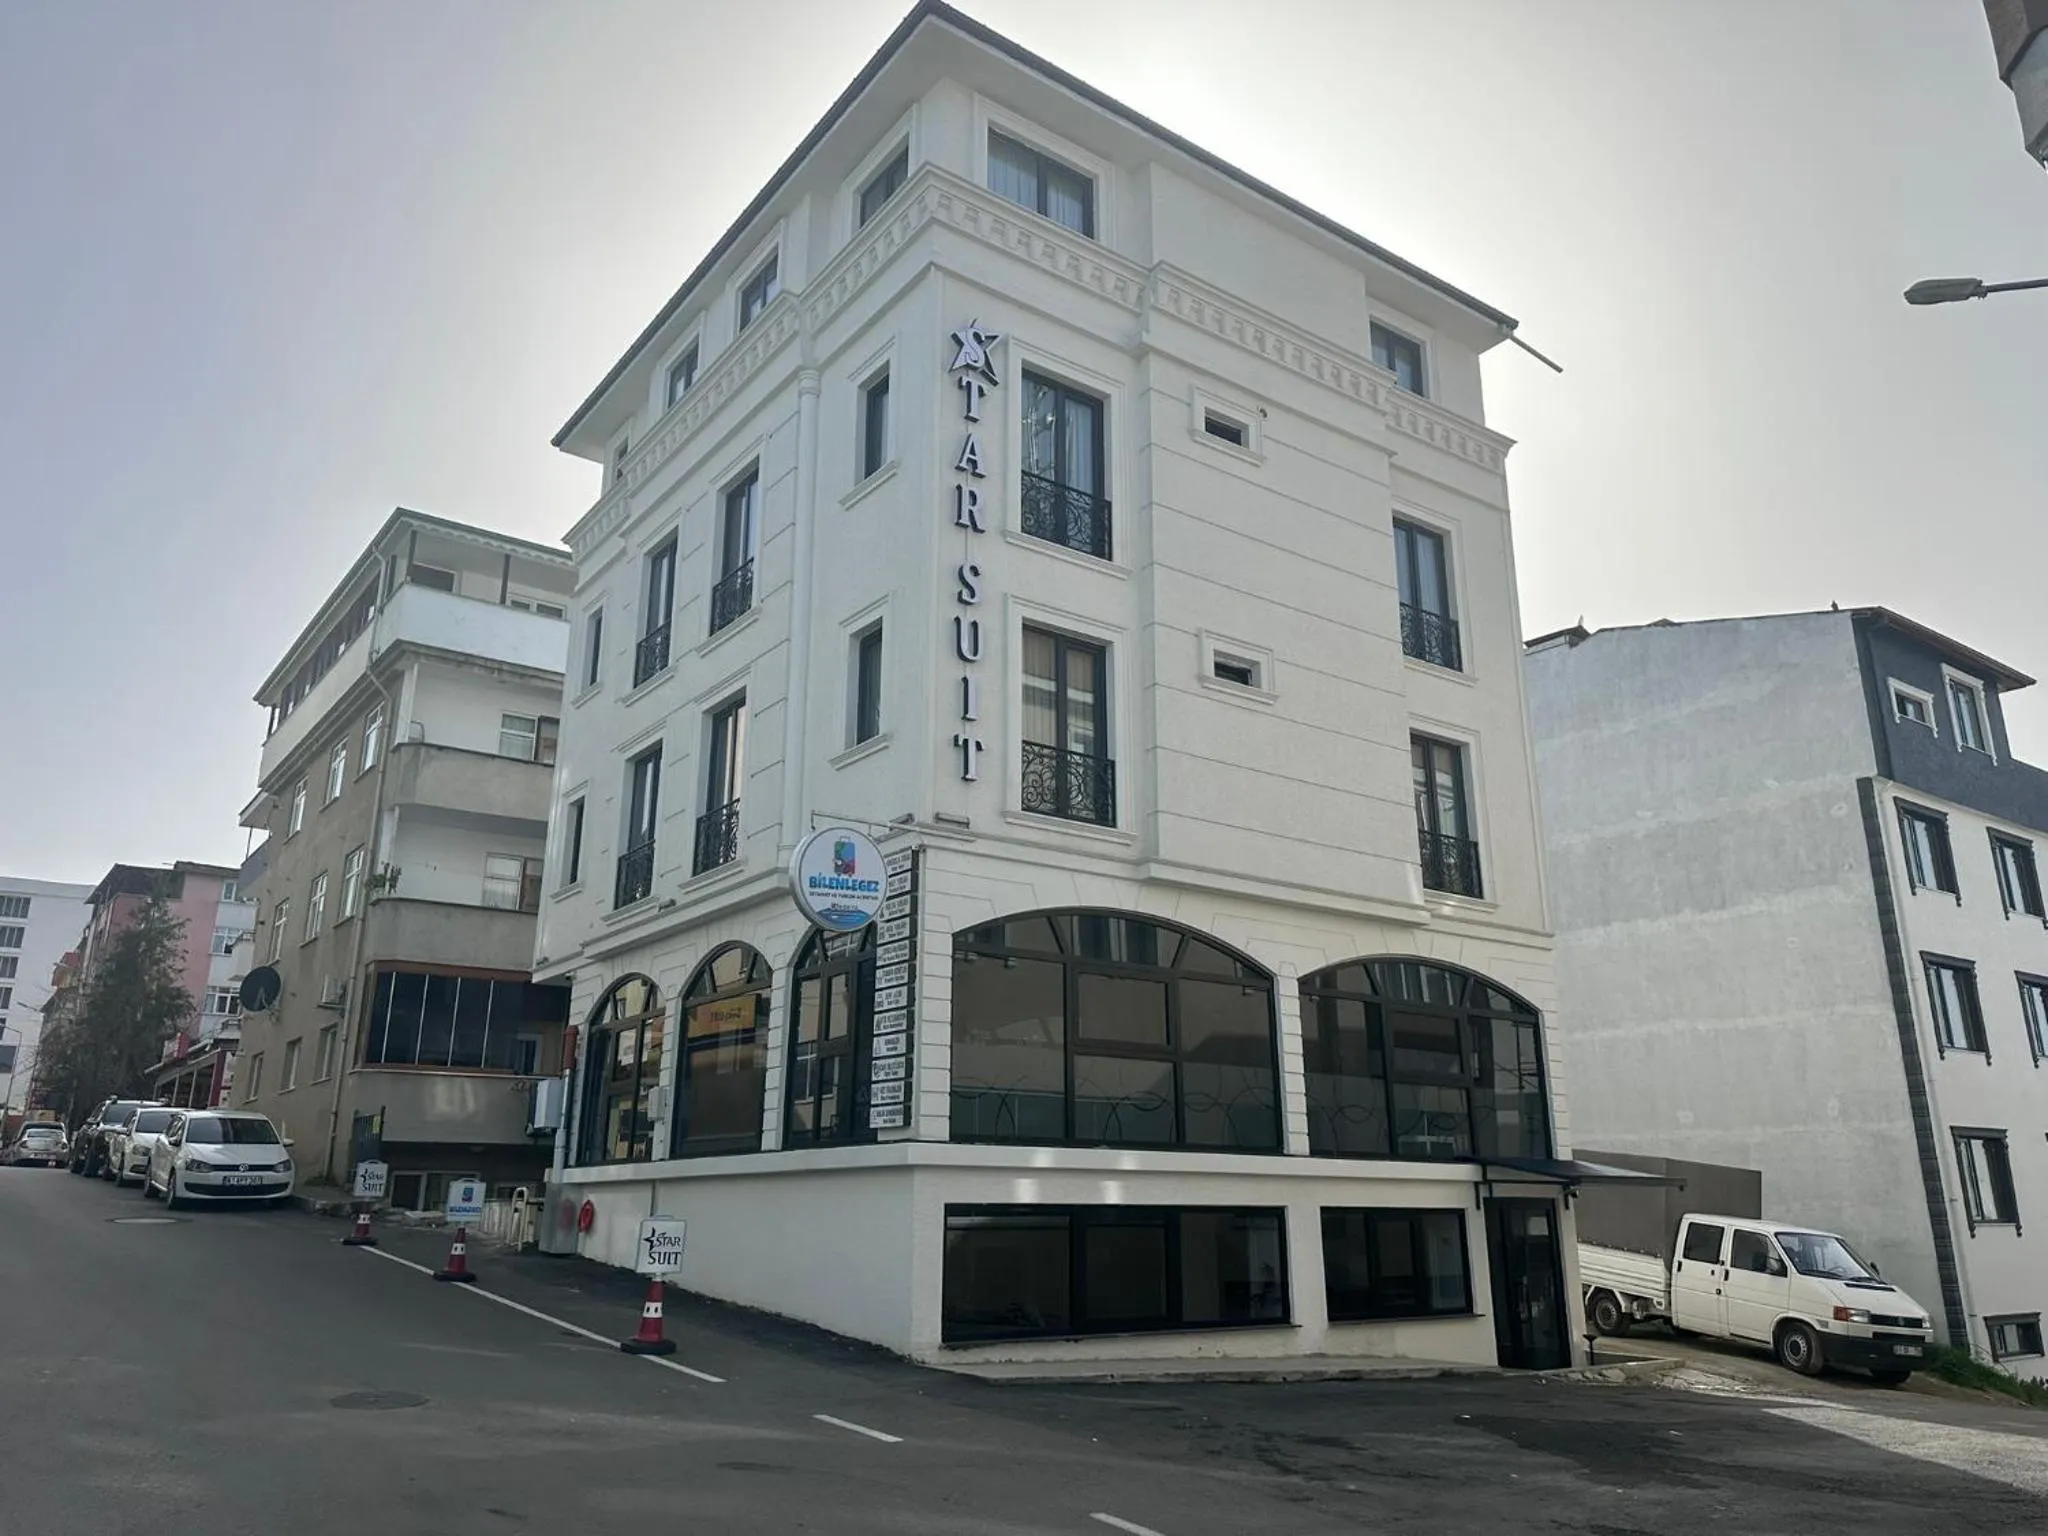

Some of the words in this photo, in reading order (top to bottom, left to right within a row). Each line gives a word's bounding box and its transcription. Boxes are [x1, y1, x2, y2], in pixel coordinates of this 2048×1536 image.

[952, 326, 989, 534] STAR
[953, 559, 984, 782] SUIT
[808, 872, 880, 893] BİLENLEGEZ
[361, 1182, 383, 1193] SUIT
[653, 1234, 682, 1248] STAR
[647, 1251, 682, 1266] SUIT
